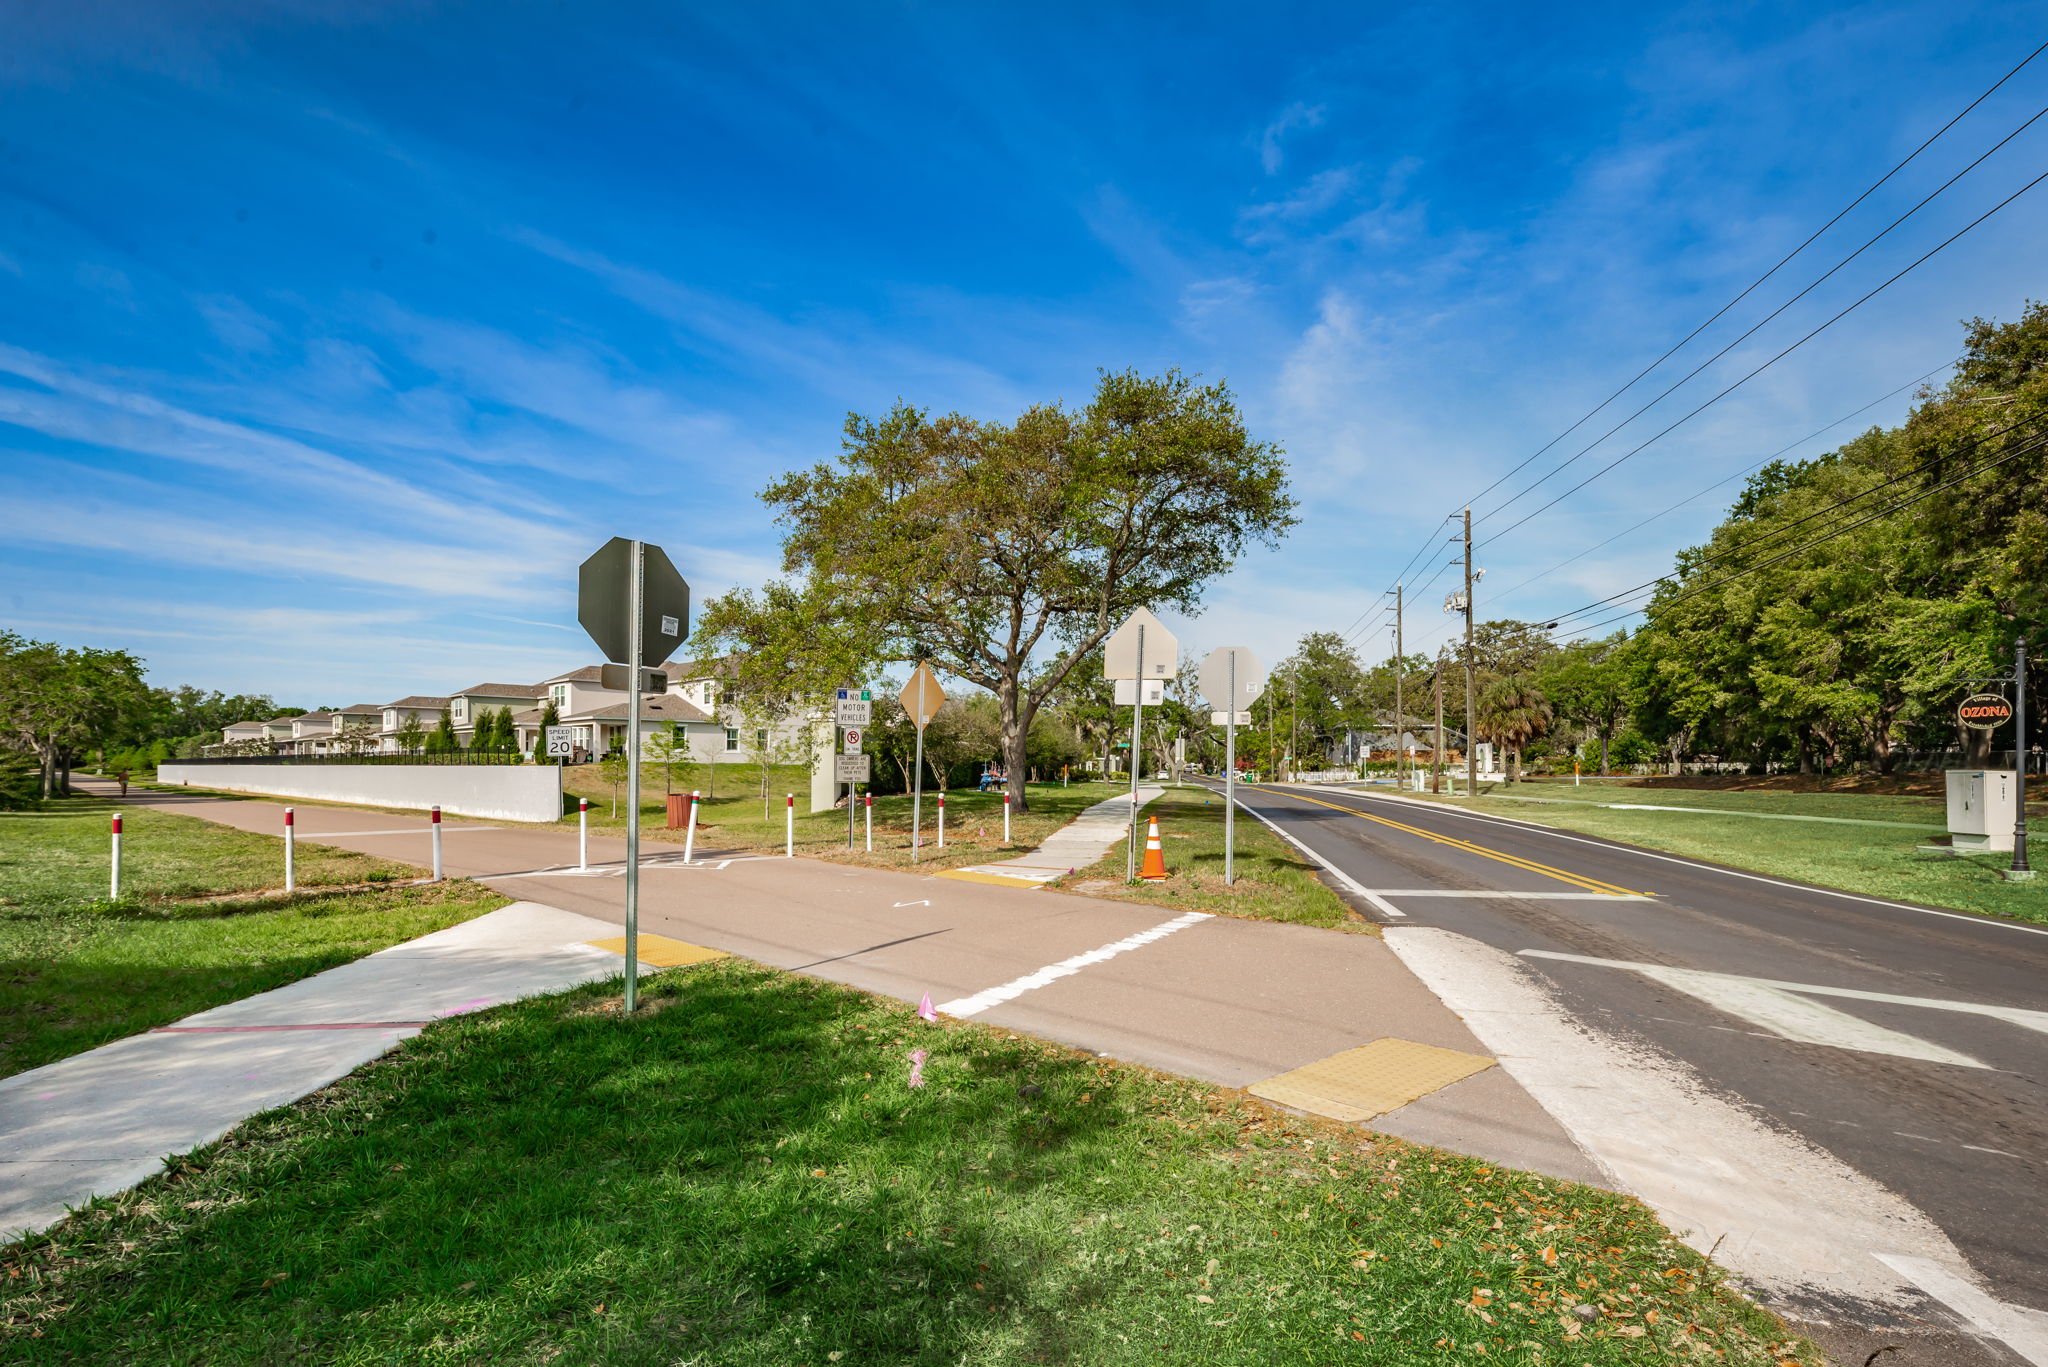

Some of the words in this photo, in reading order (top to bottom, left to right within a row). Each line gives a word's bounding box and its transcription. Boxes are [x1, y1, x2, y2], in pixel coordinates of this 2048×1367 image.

[850, 693, 859, 701] NO
[841, 713, 866, 721] VEHICLES
[1961, 706, 2009, 718] OZONA
[550, 741, 570, 753] 20
